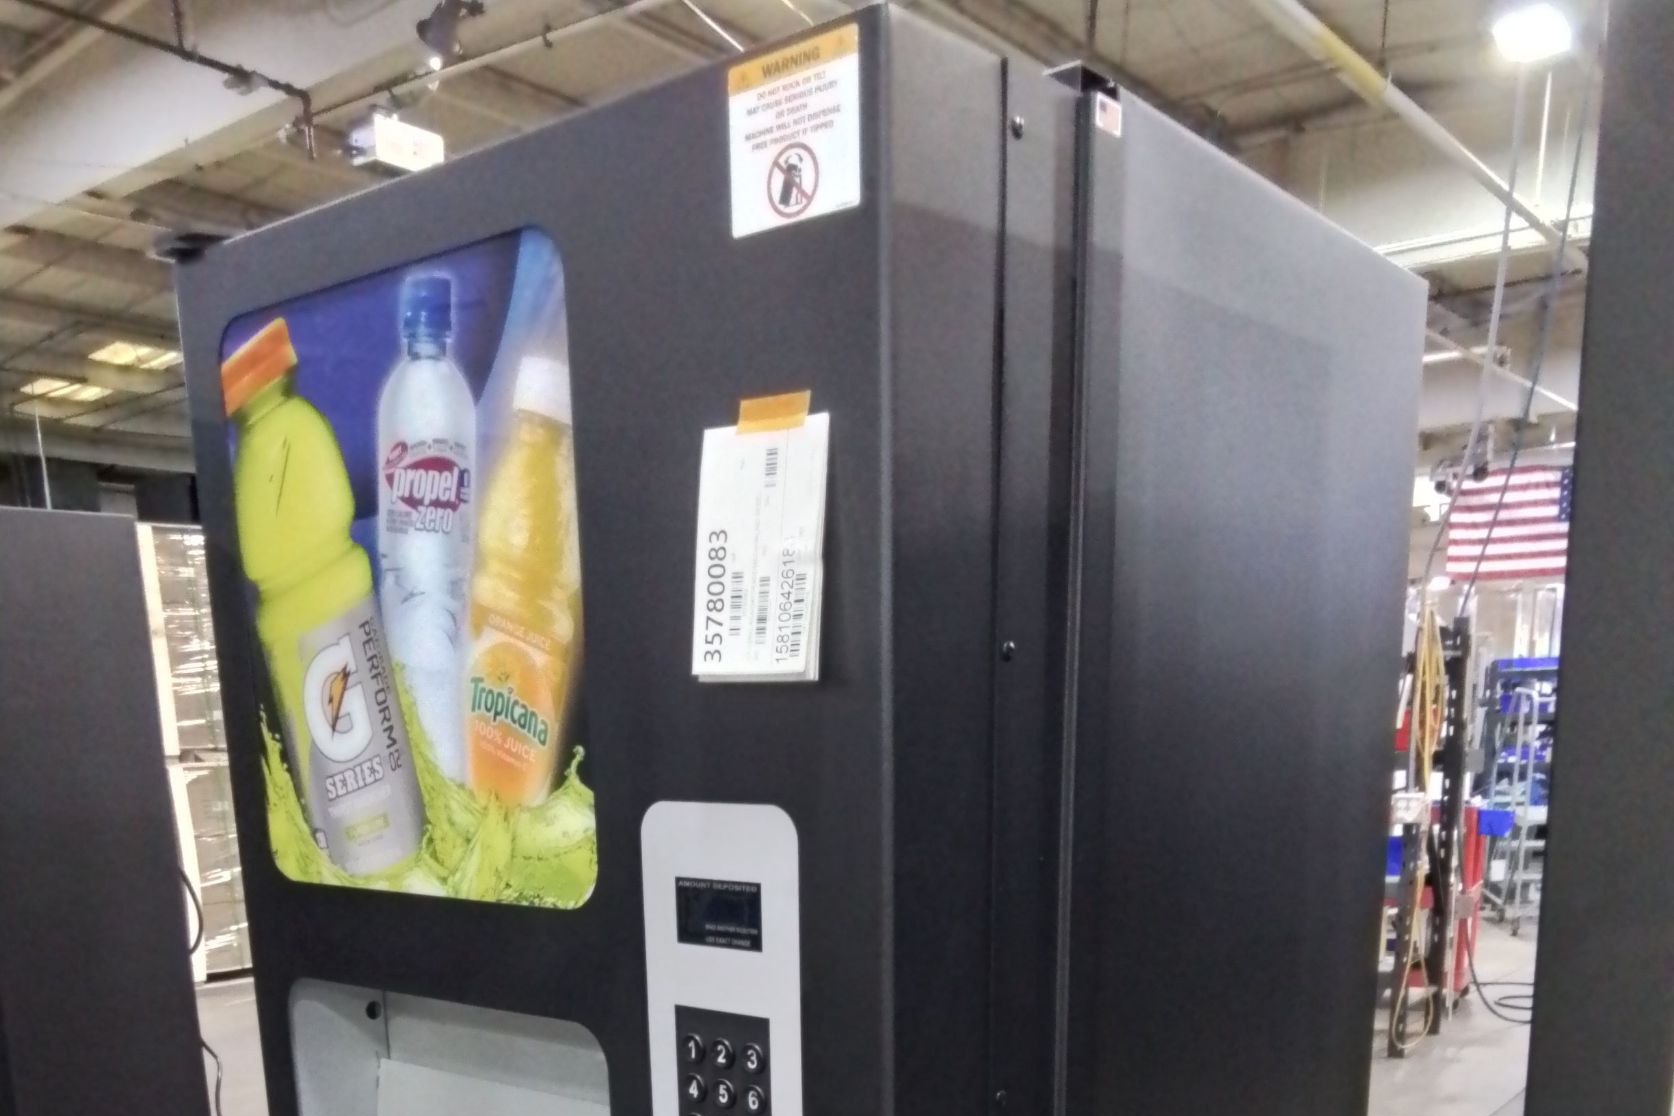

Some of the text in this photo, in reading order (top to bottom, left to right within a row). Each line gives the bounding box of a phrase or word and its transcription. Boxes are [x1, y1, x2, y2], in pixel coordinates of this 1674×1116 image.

[761, 46, 820, 79] WARNING
[389, 465, 460, 505] propel
[414, 505, 453, 534] zero
[704, 529, 728, 663] 35780083
[358, 620, 398, 749] PERFORM
[470, 676, 549, 747] Tropicana
[474, 719, 503, 744] 100%
[503, 736, 537, 763] JUICE
[325, 754, 384, 801] SERIES
[678, 880, 758, 893] AMOUNT DEPOSITED
[688, 1041, 757, 1069] 1 2 3
[688, 1079, 759, 1110] 4 5 6
